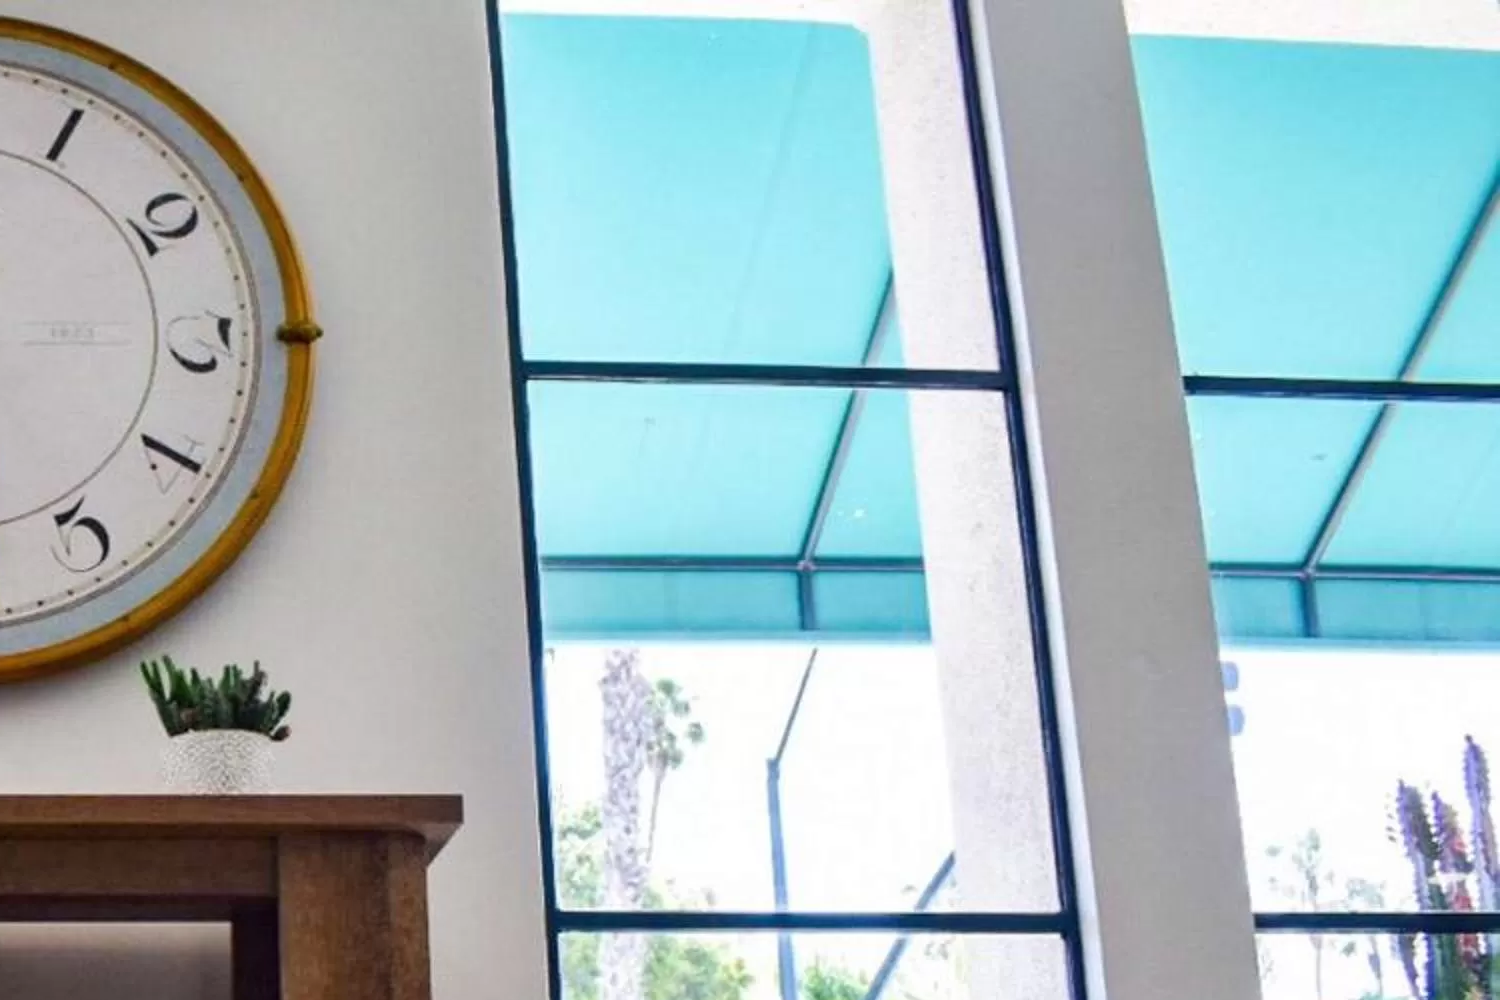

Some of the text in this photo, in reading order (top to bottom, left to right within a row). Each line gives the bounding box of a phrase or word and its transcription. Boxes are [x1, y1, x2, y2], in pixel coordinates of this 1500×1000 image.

[45, 107, 87, 164] 1
[124, 191, 201, 258] 2
[165, 308, 234, 376] 3
[140, 431, 206, 495] 4
[49, 494, 112, 575] 5
